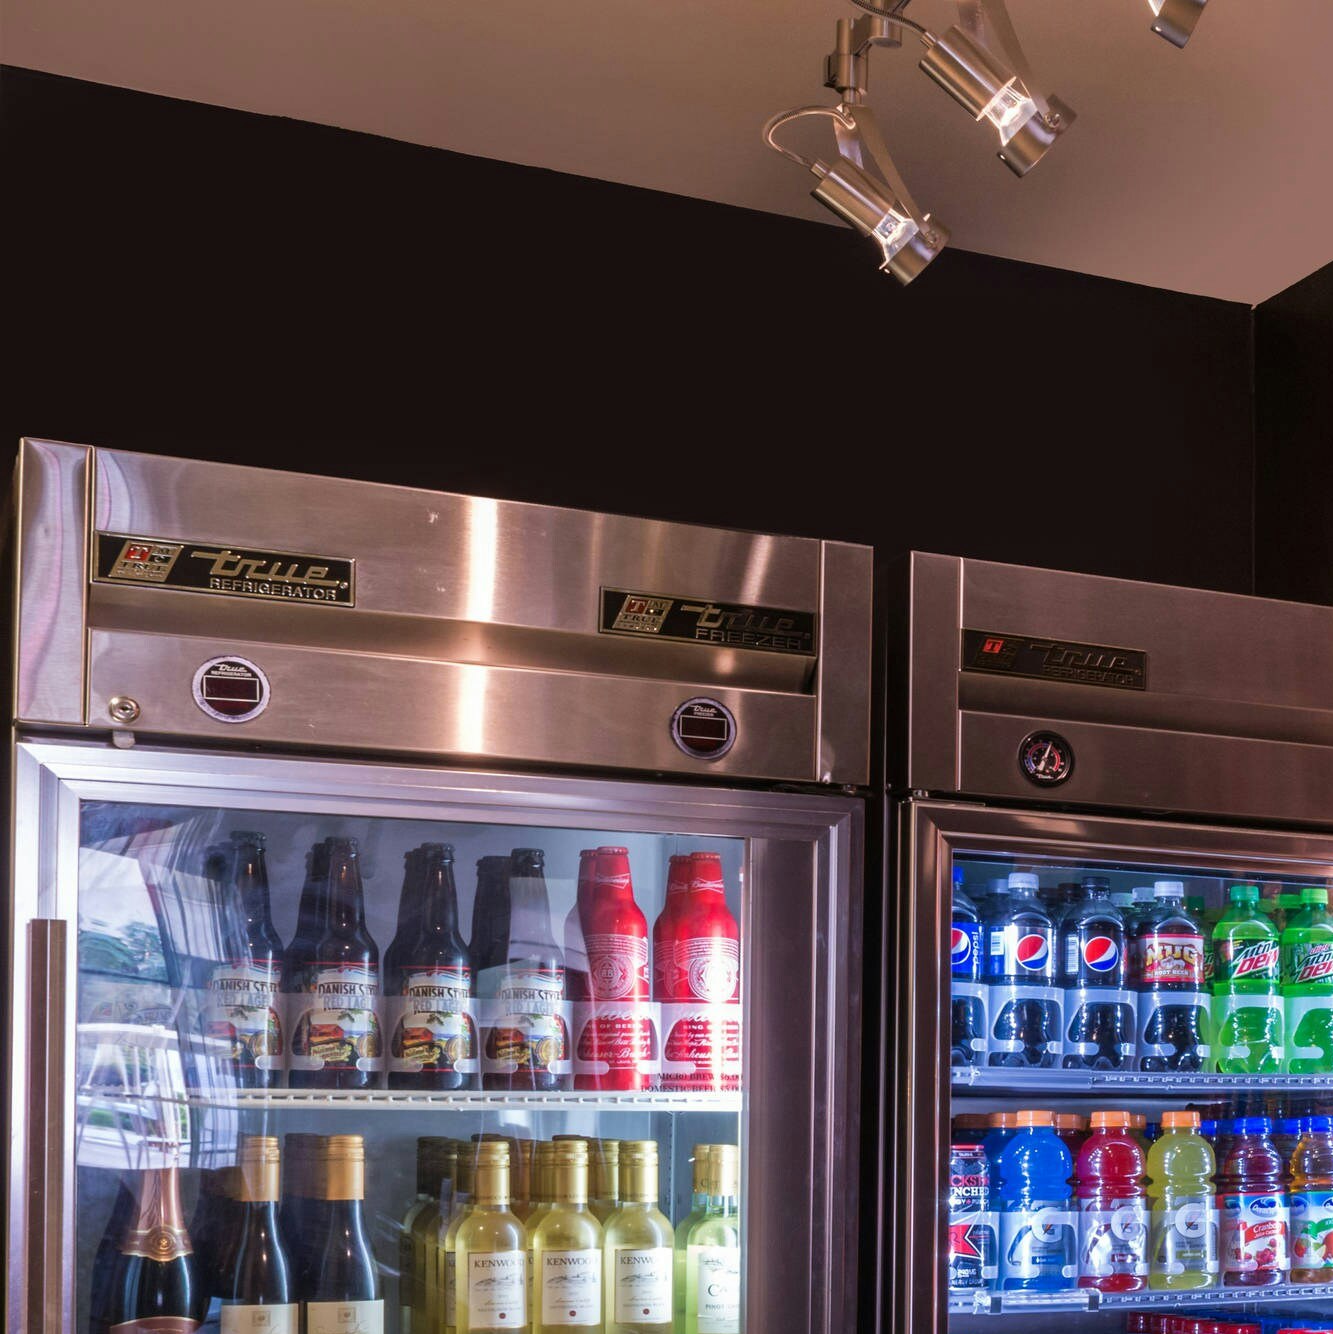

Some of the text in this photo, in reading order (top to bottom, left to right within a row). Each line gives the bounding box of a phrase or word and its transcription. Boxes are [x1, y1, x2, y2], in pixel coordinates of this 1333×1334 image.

[209, 577, 337, 601] REFRIGERATOR
[695, 628, 801, 650] FREEZER
[971, 930, 980, 966] pepsi
[1146, 943, 1200, 968] MUG
[318, 982, 356, 998] DANISH
[409, 986, 445, 999] DANISH
